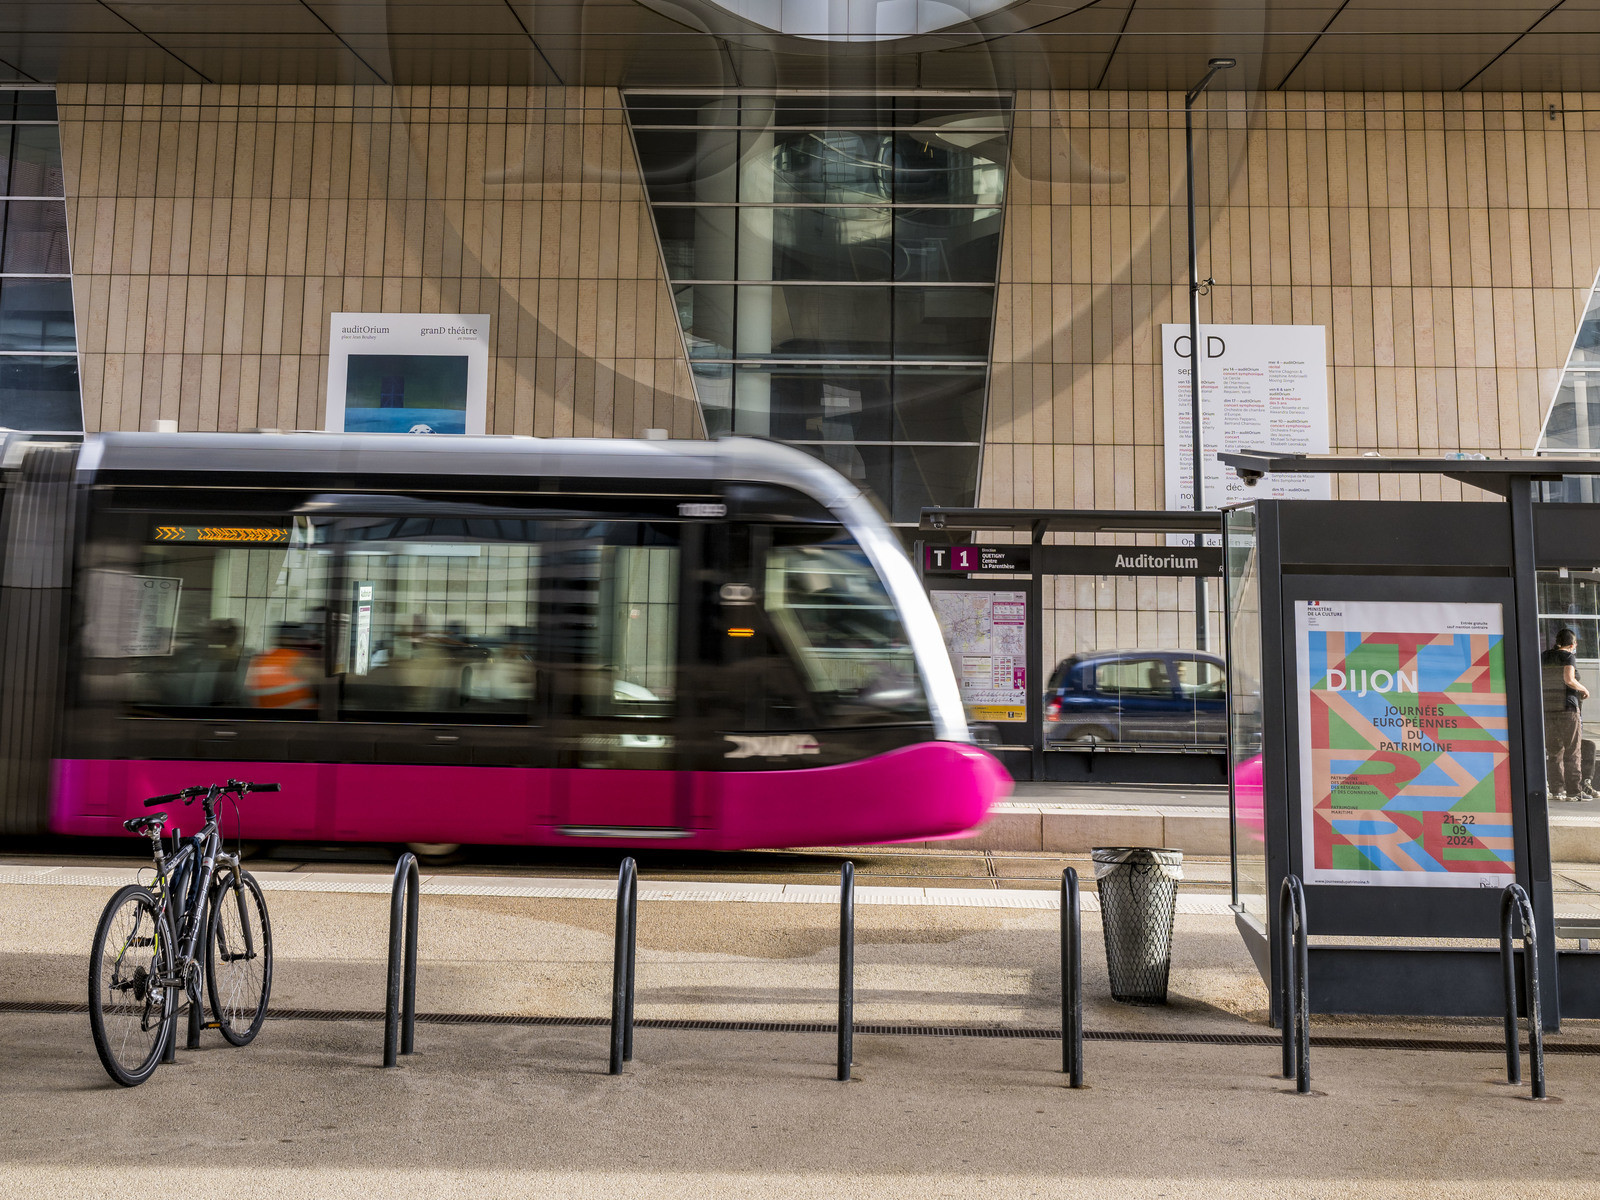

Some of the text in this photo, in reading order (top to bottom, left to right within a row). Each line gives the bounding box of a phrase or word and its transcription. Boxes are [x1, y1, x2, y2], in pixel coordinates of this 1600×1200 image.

[342, 325, 390, 334] auditOrium
[420, 326, 478, 336] granD théâtre
[1226, 483, 1244, 491] déc.
[934, 550, 969, 567] T 1
[1115, 554, 1199, 568] Auditorium
[1327, 669, 1418, 697] DIJON
[1385, 705, 1444, 717] JOURNÉES
[1373, 717, 1458, 728] EUROPÉENNES
[1408, 730, 1424, 740] DU
[1380, 742, 1452, 752] PATRIMOINE
[1453, 825, 1466, 834] 09
[1447, 836, 1474, 845] 2024
